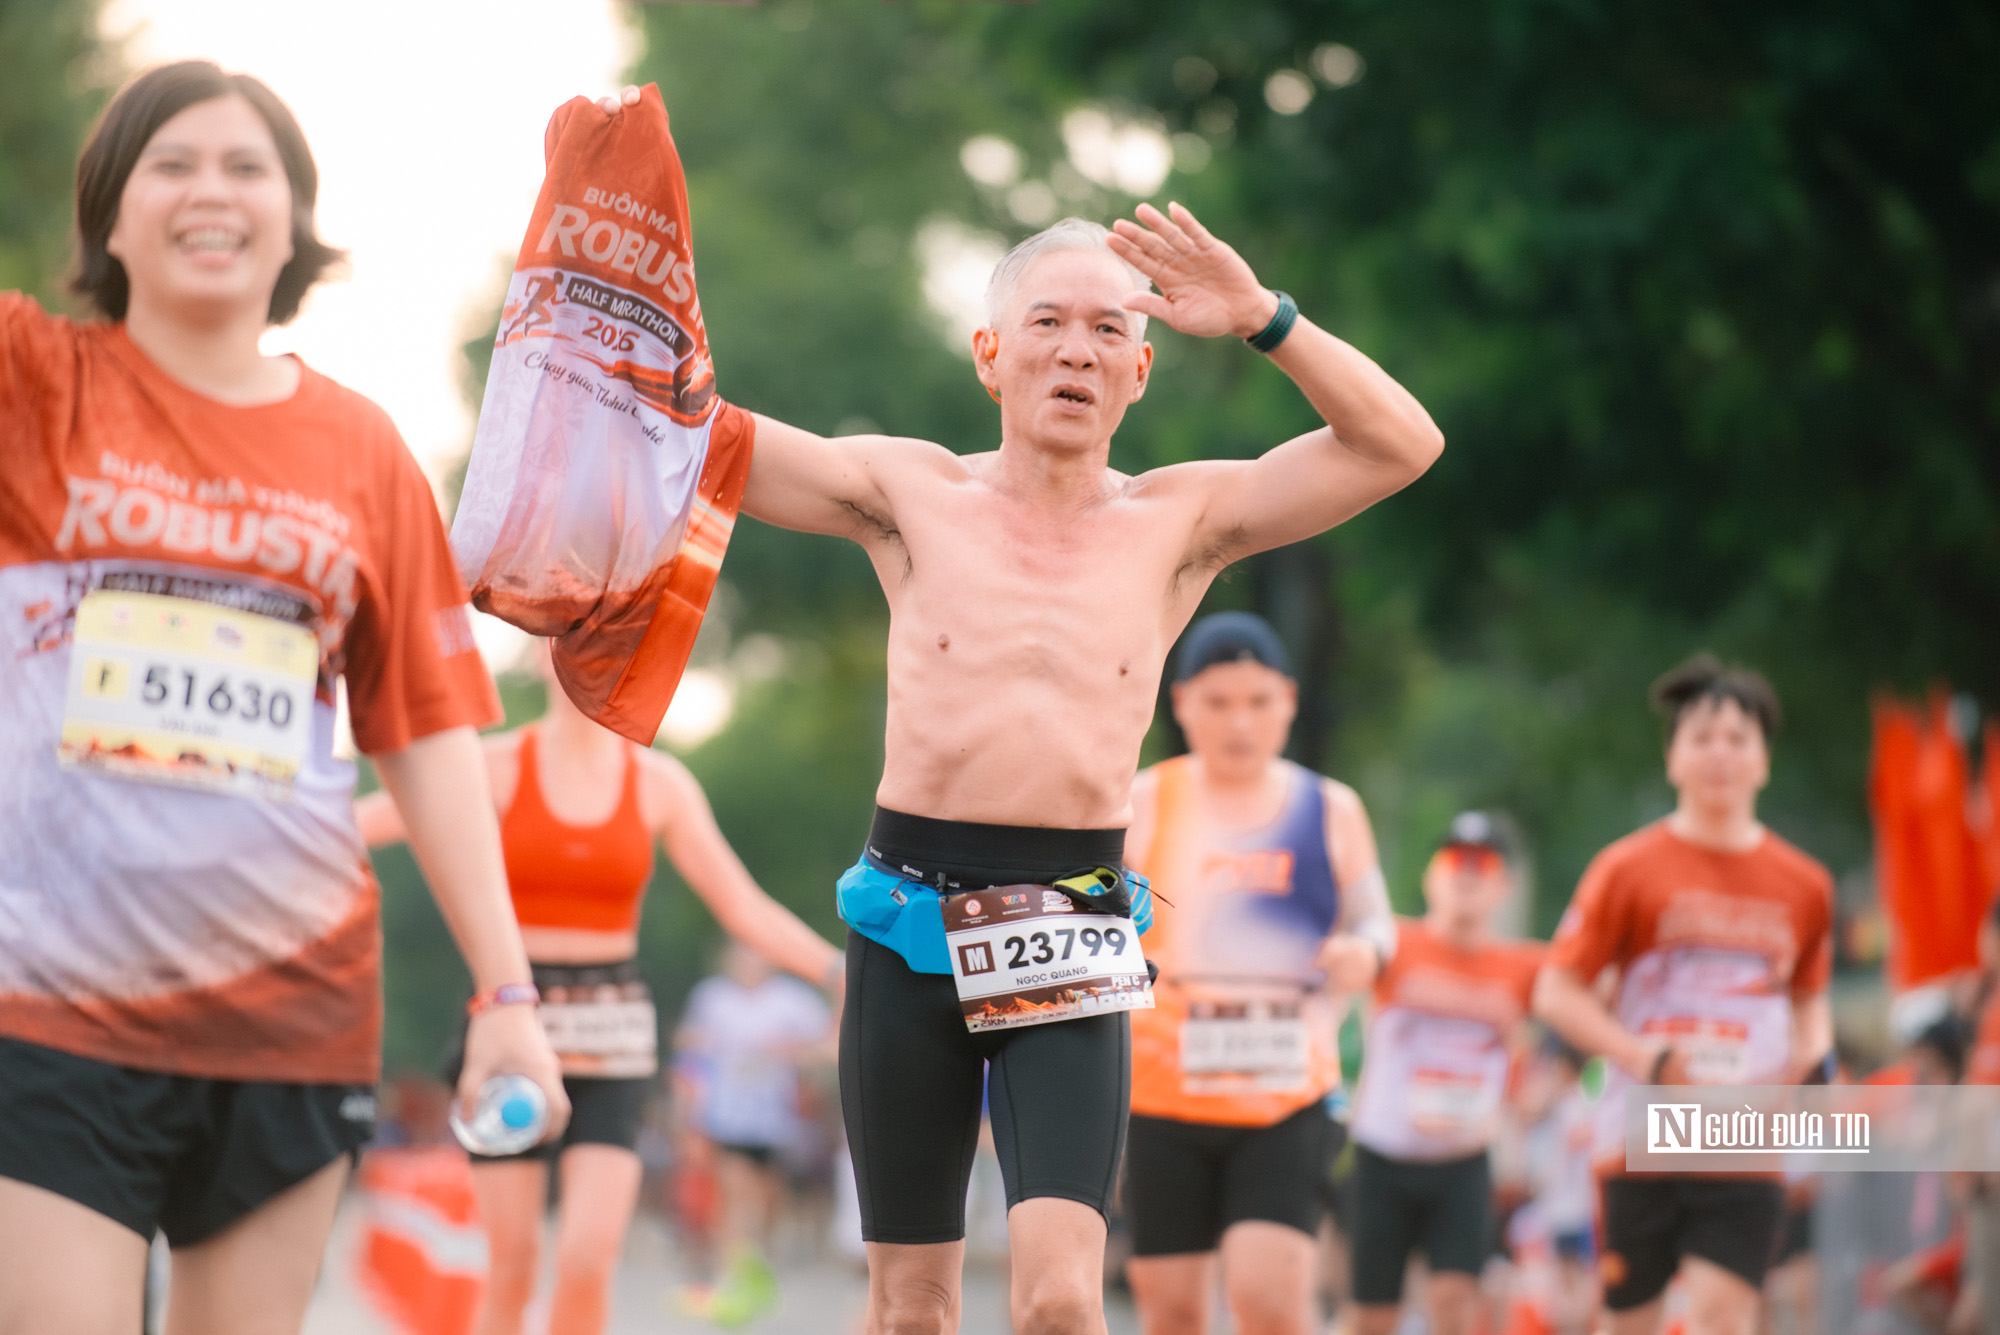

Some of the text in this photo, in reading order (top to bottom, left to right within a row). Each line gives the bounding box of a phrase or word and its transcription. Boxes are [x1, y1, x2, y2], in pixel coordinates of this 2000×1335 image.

[583, 187, 677, 241] BUÔN MA
[536, 203, 703, 330] ROBUS
[570, 283, 610, 307] HALF
[524, 351, 567, 381] Chạy
[566, 371, 594, 393] giữa
[55, 475, 358, 622] ROBUSTA
[142, 664, 293, 729] 51630
[966, 927, 1127, 973] M 23799
[1016, 966, 1088, 987] NGỌC QUANG
[1111, 975, 1140, 987] PEN C
